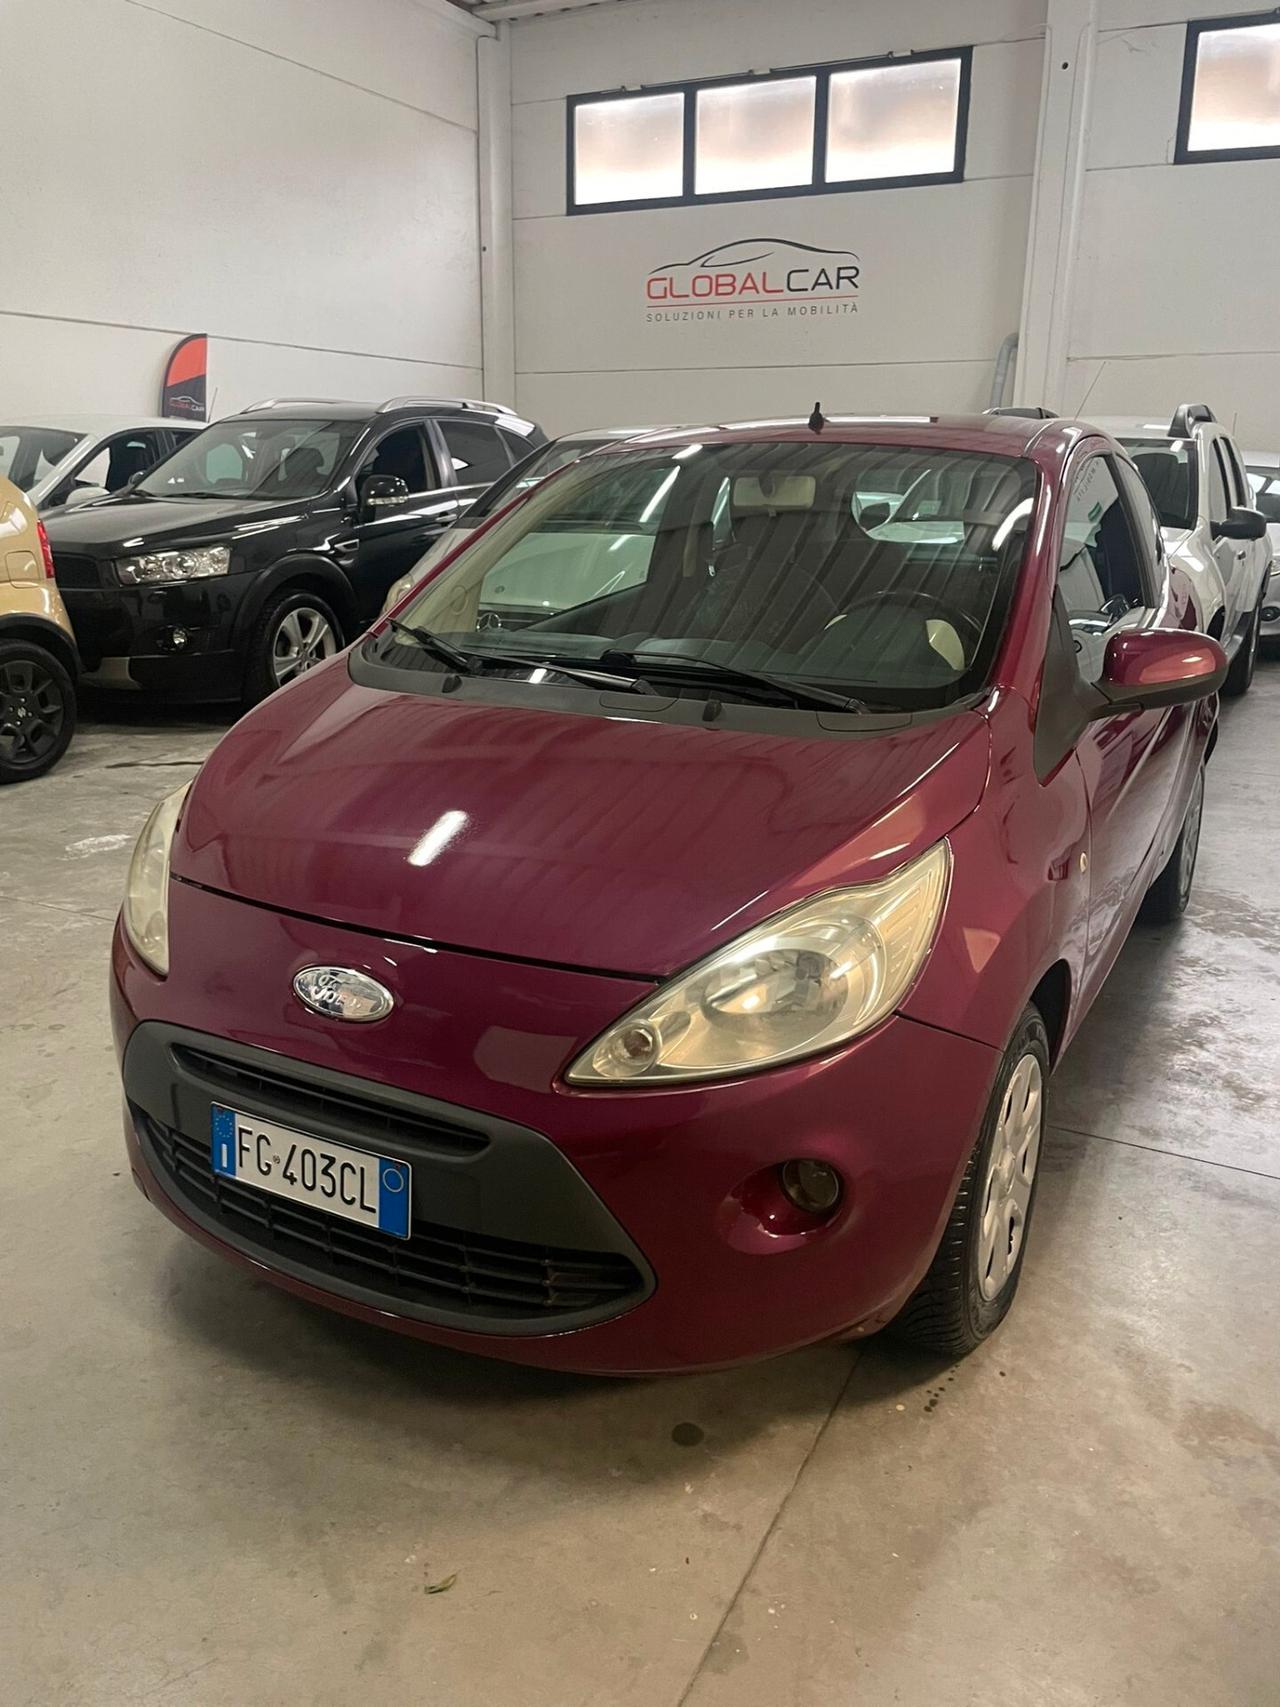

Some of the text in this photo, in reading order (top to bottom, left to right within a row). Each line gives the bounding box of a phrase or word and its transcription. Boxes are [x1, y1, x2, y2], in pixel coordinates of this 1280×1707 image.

[646, 266, 860, 300] GLOBALCAR
[646, 302, 859, 323] SOLUZIONI PER LA MOBILITÀ
